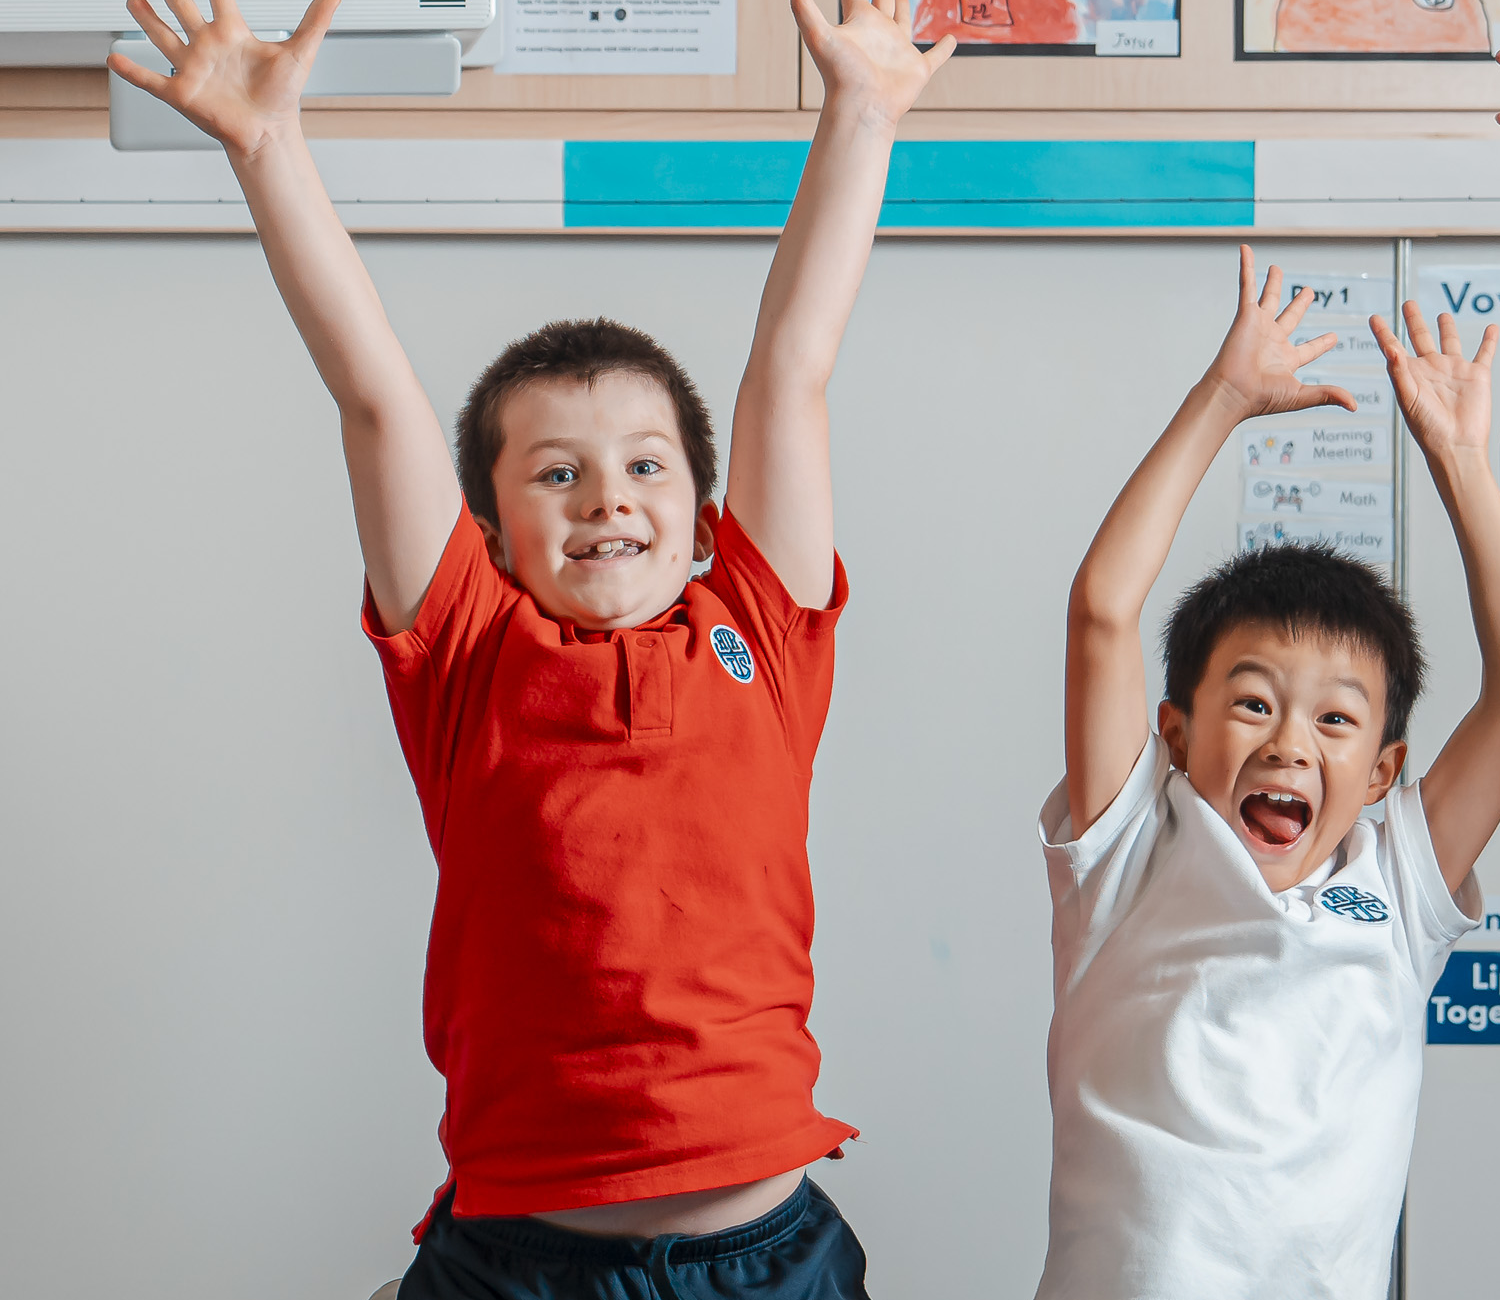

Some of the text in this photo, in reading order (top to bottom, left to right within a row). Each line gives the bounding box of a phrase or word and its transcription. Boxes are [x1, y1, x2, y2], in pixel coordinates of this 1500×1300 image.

[1312, 428, 1373, 447] Morning
[1313, 444, 1373, 462] Meeting
[1339, 490, 1377, 508] Math
[1336, 531, 1382, 550] Friday
